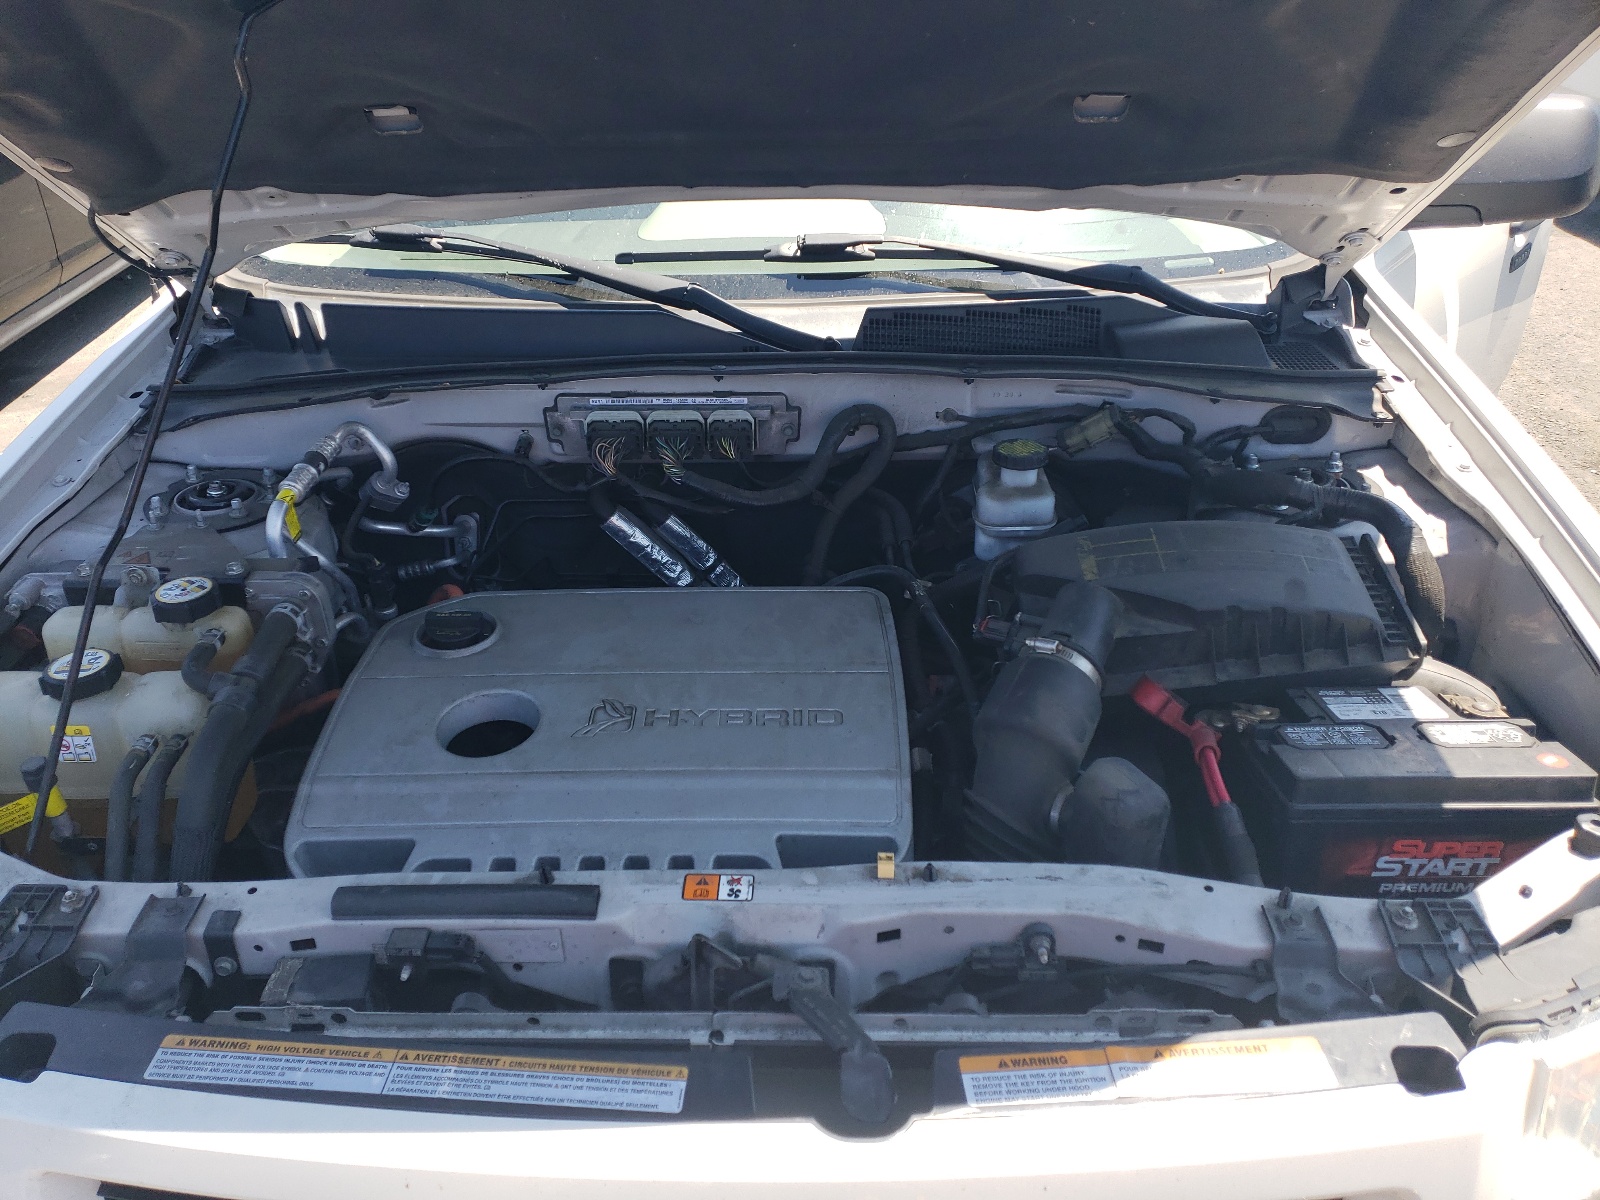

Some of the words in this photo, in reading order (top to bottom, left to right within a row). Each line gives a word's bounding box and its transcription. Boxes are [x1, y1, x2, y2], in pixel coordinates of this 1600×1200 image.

[643, 708, 844, 726] HYBRID
[1390, 839, 1504, 858] SUPER
[1371, 856, 1500, 877] START
[1378, 882, 1474, 894] PREMIUM
[189, 1039, 250, 1050] WARNING:
[256, 1045, 280, 1053] HIGH
[283, 1047, 325, 1056] VOLTAGE
[328, 1050, 370, 1059] VEHICLE
[1169, 1044, 1269, 1058] AVERTISSEMENT
[413, 1053, 501, 1067] AVERTISSEMENT
[509, 1061, 548, 1070] CIRCUITS
[550, 1064, 577, 1072] HAUTE
[579, 1066, 615, 1075] TENSION
[631, 1067, 673, 1078] VÉHICULE
[1010, 1055, 1068, 1068] WARNING
[973, 1082, 1003, 1090] REMOVE
